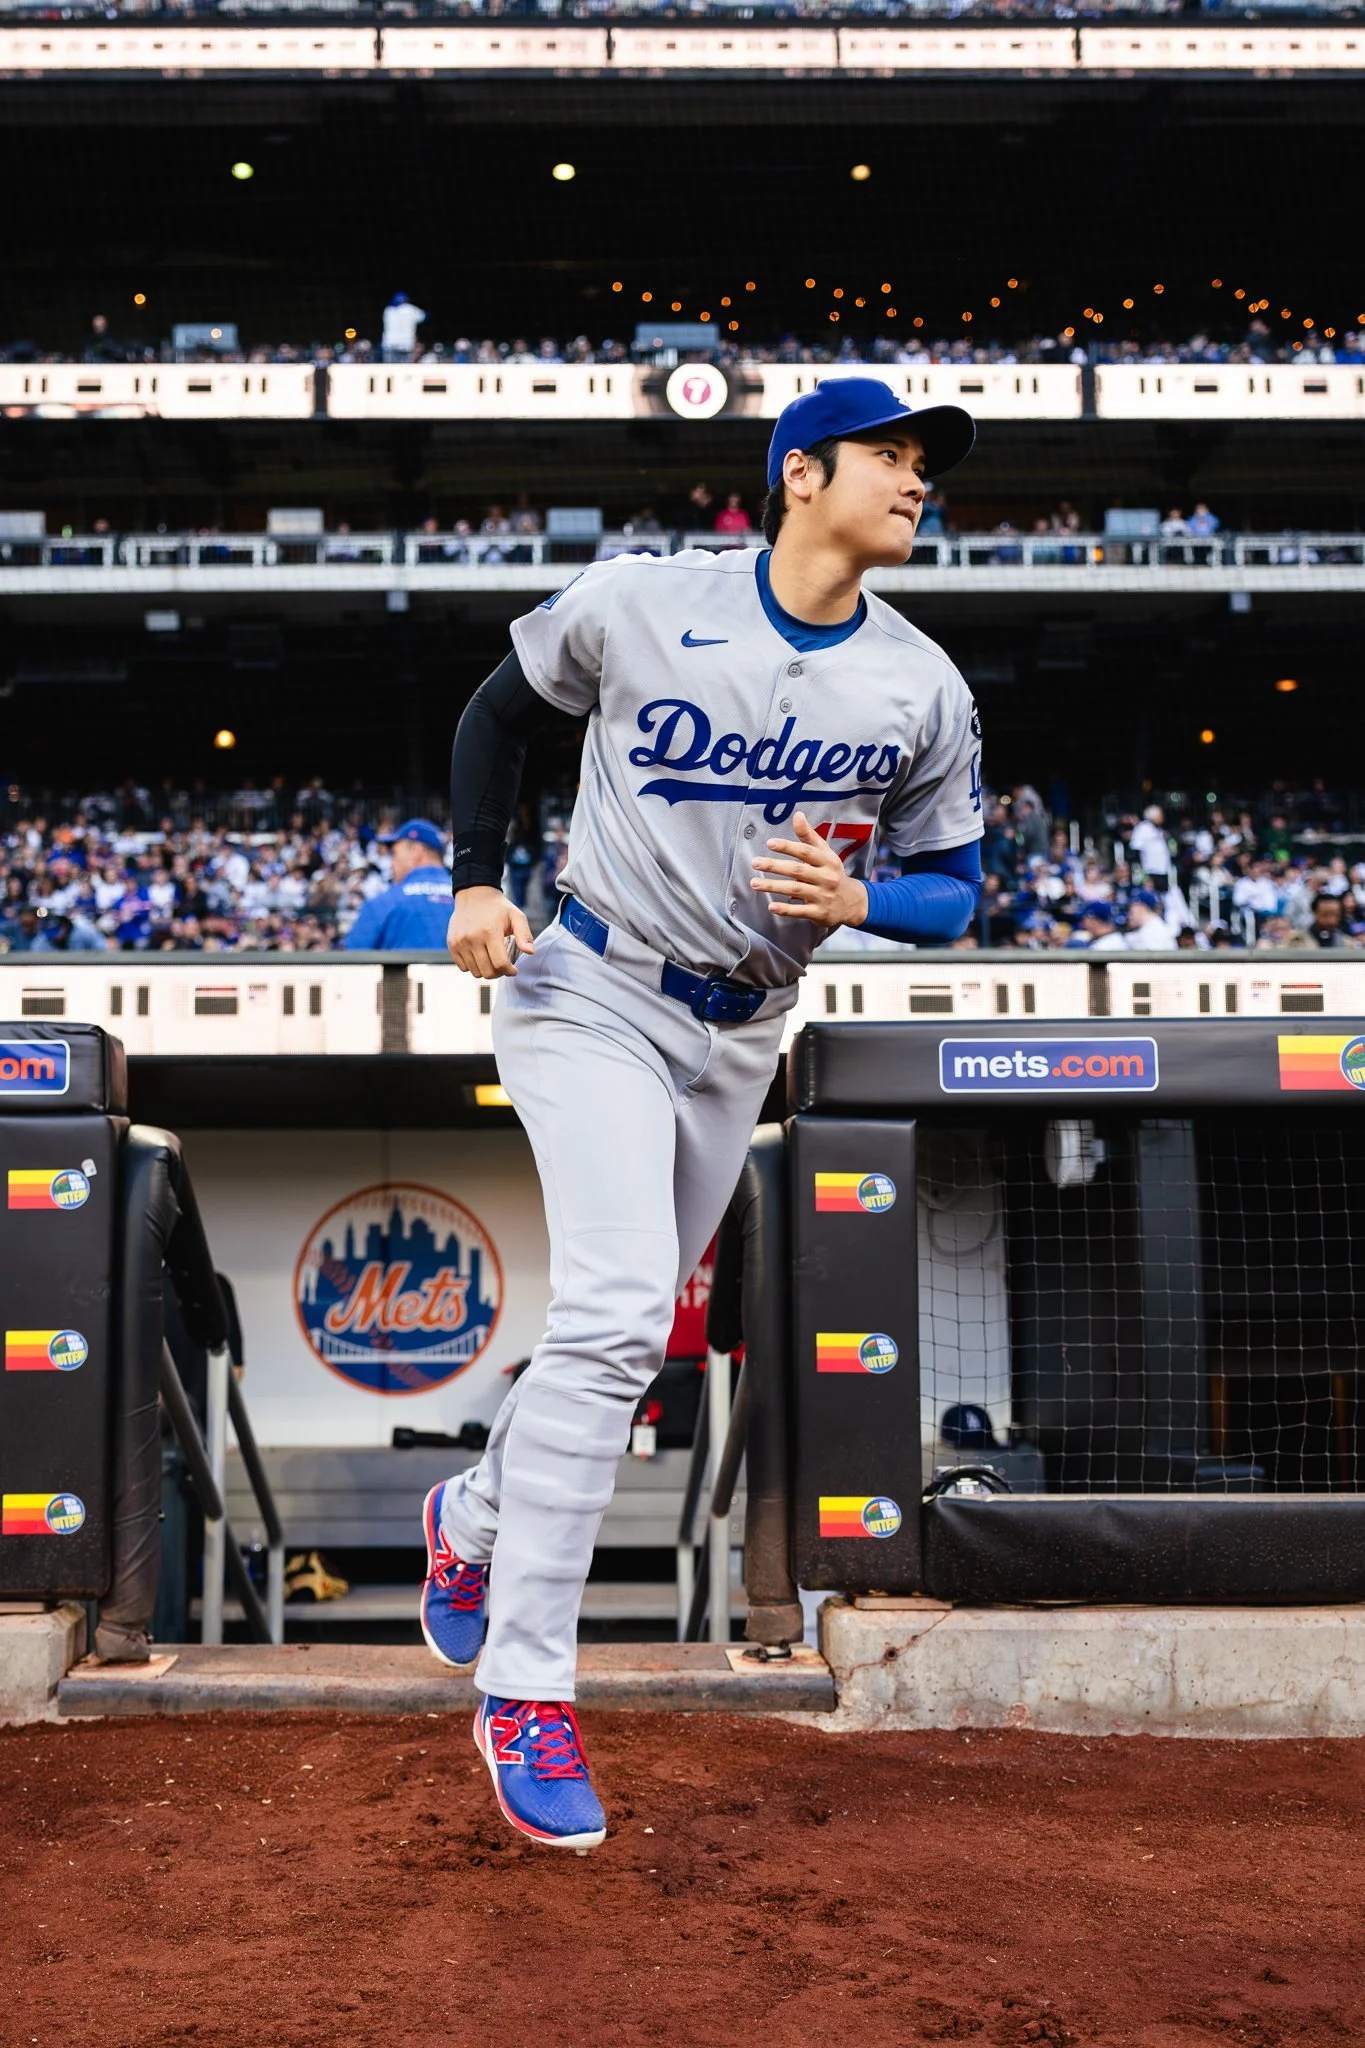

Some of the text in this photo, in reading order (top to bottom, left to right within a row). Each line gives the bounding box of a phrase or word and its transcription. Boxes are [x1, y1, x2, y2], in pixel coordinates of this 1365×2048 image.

[629, 699, 900, 825] Dodgers
[953, 1051, 1144, 1078] mets.com
[324, 1261, 470, 1333] Mets
